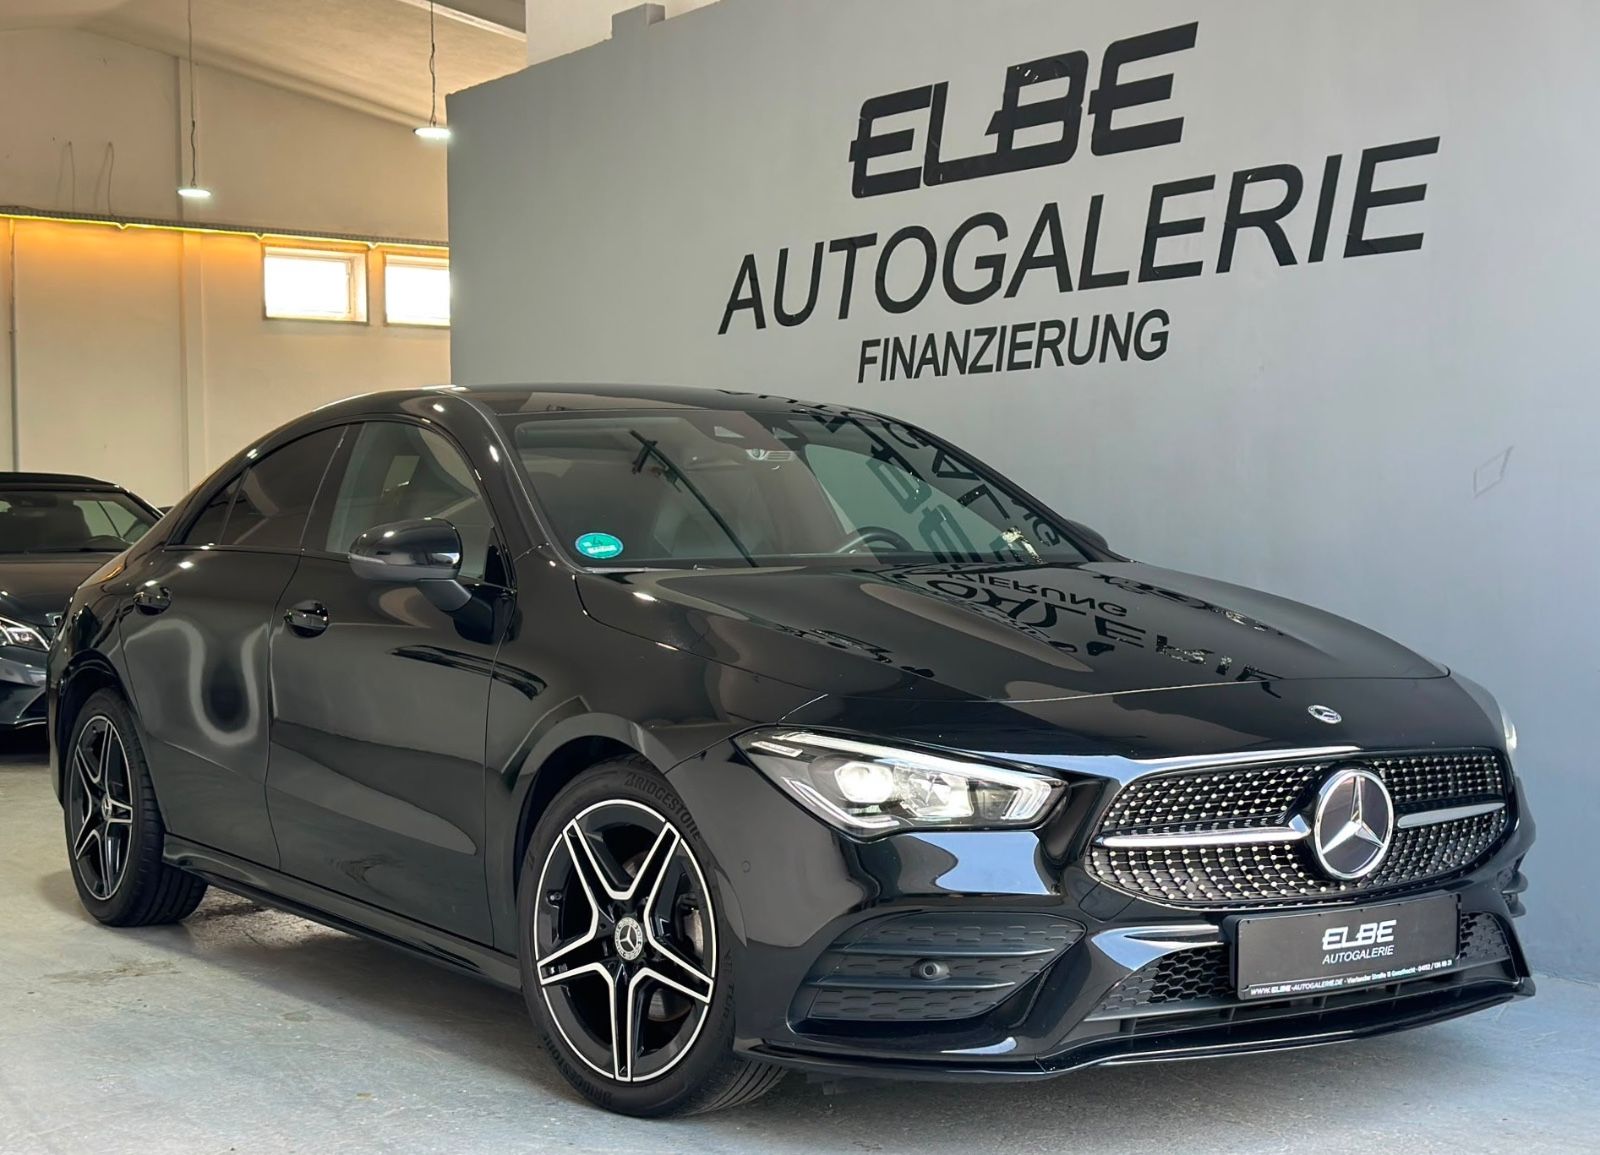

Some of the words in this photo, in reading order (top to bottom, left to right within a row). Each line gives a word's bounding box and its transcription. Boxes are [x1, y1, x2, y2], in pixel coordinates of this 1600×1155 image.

[849, 21, 1199, 199] ELBE
[718, 136, 1440, 335] AUTOGALERIE
[857, 308, 1170, 384] FINANZIERUNG
[623, 771, 702, 842] BRIDGESTONE
[1322, 920, 1396, 950] ELBE
[1322, 945, 1394, 964] AUTOGALERIE
